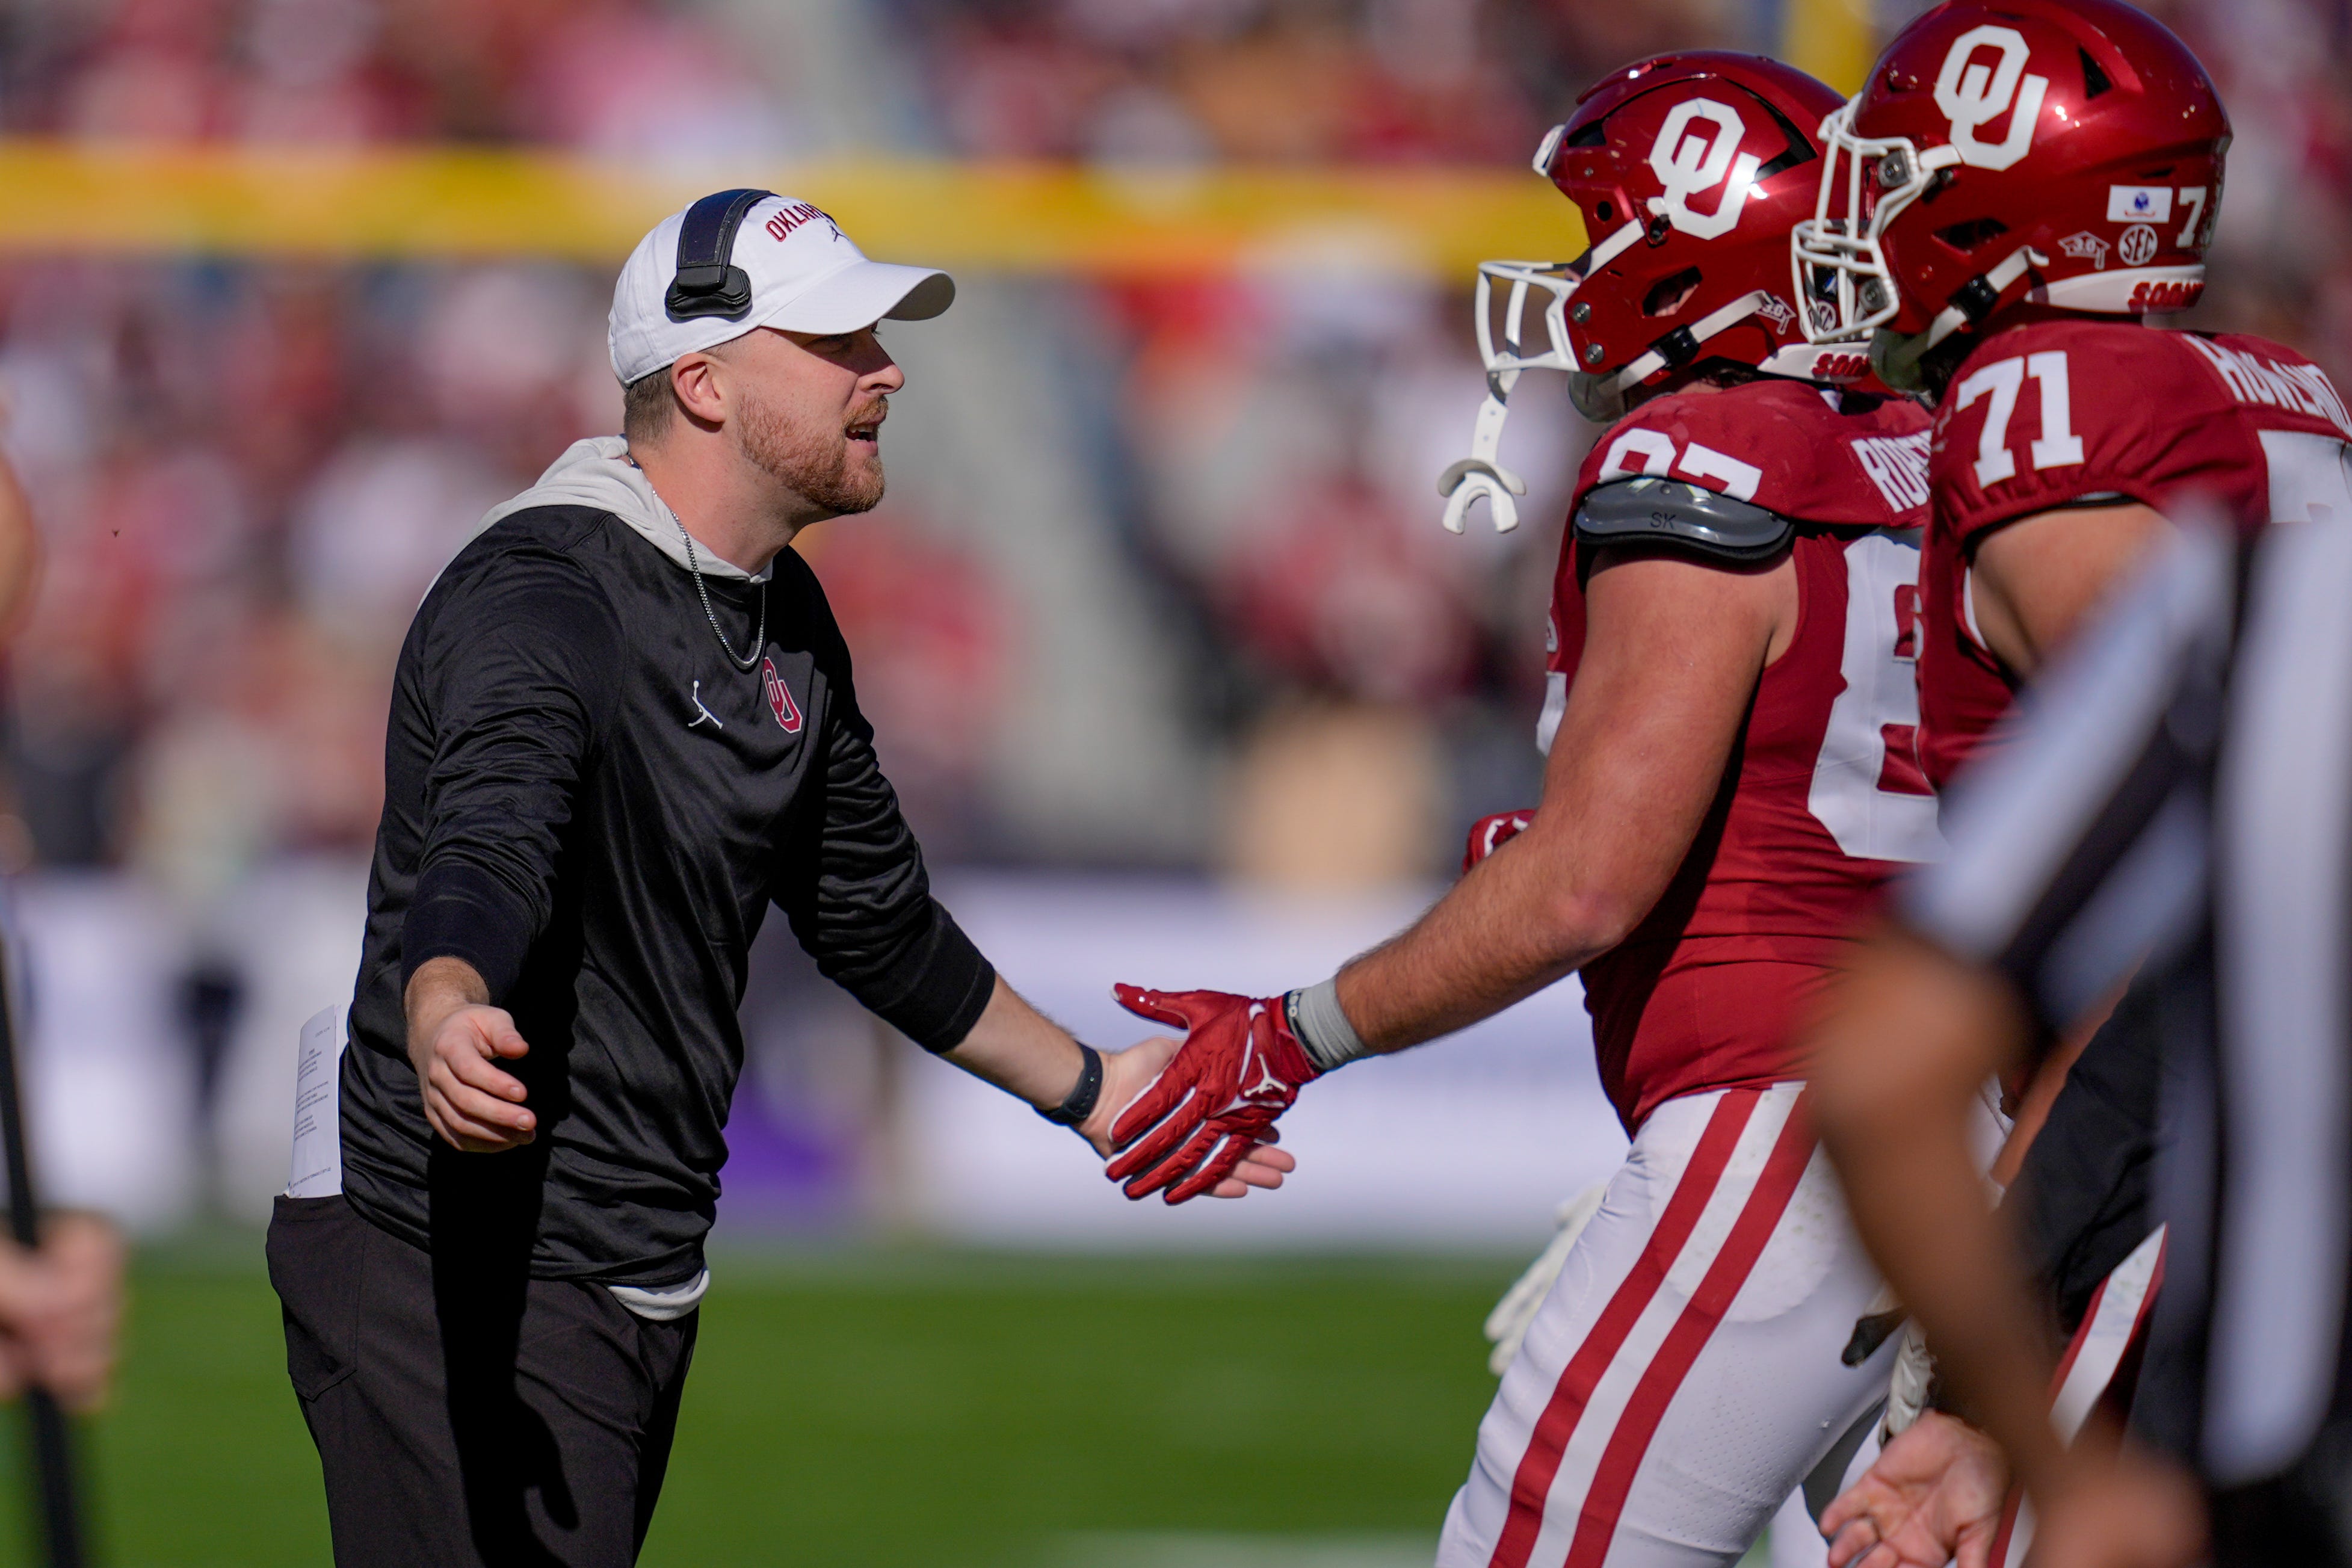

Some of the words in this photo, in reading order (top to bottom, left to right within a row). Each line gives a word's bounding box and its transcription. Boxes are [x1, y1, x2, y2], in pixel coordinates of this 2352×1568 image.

[1933, 24, 2049, 172] OU
[765, 203, 827, 242] OKLAH
[1649, 97, 1762, 241] OU
[1955, 350, 2085, 490] 71
[1650, 511, 1676, 530] SK
[762, 656, 803, 734] OU
